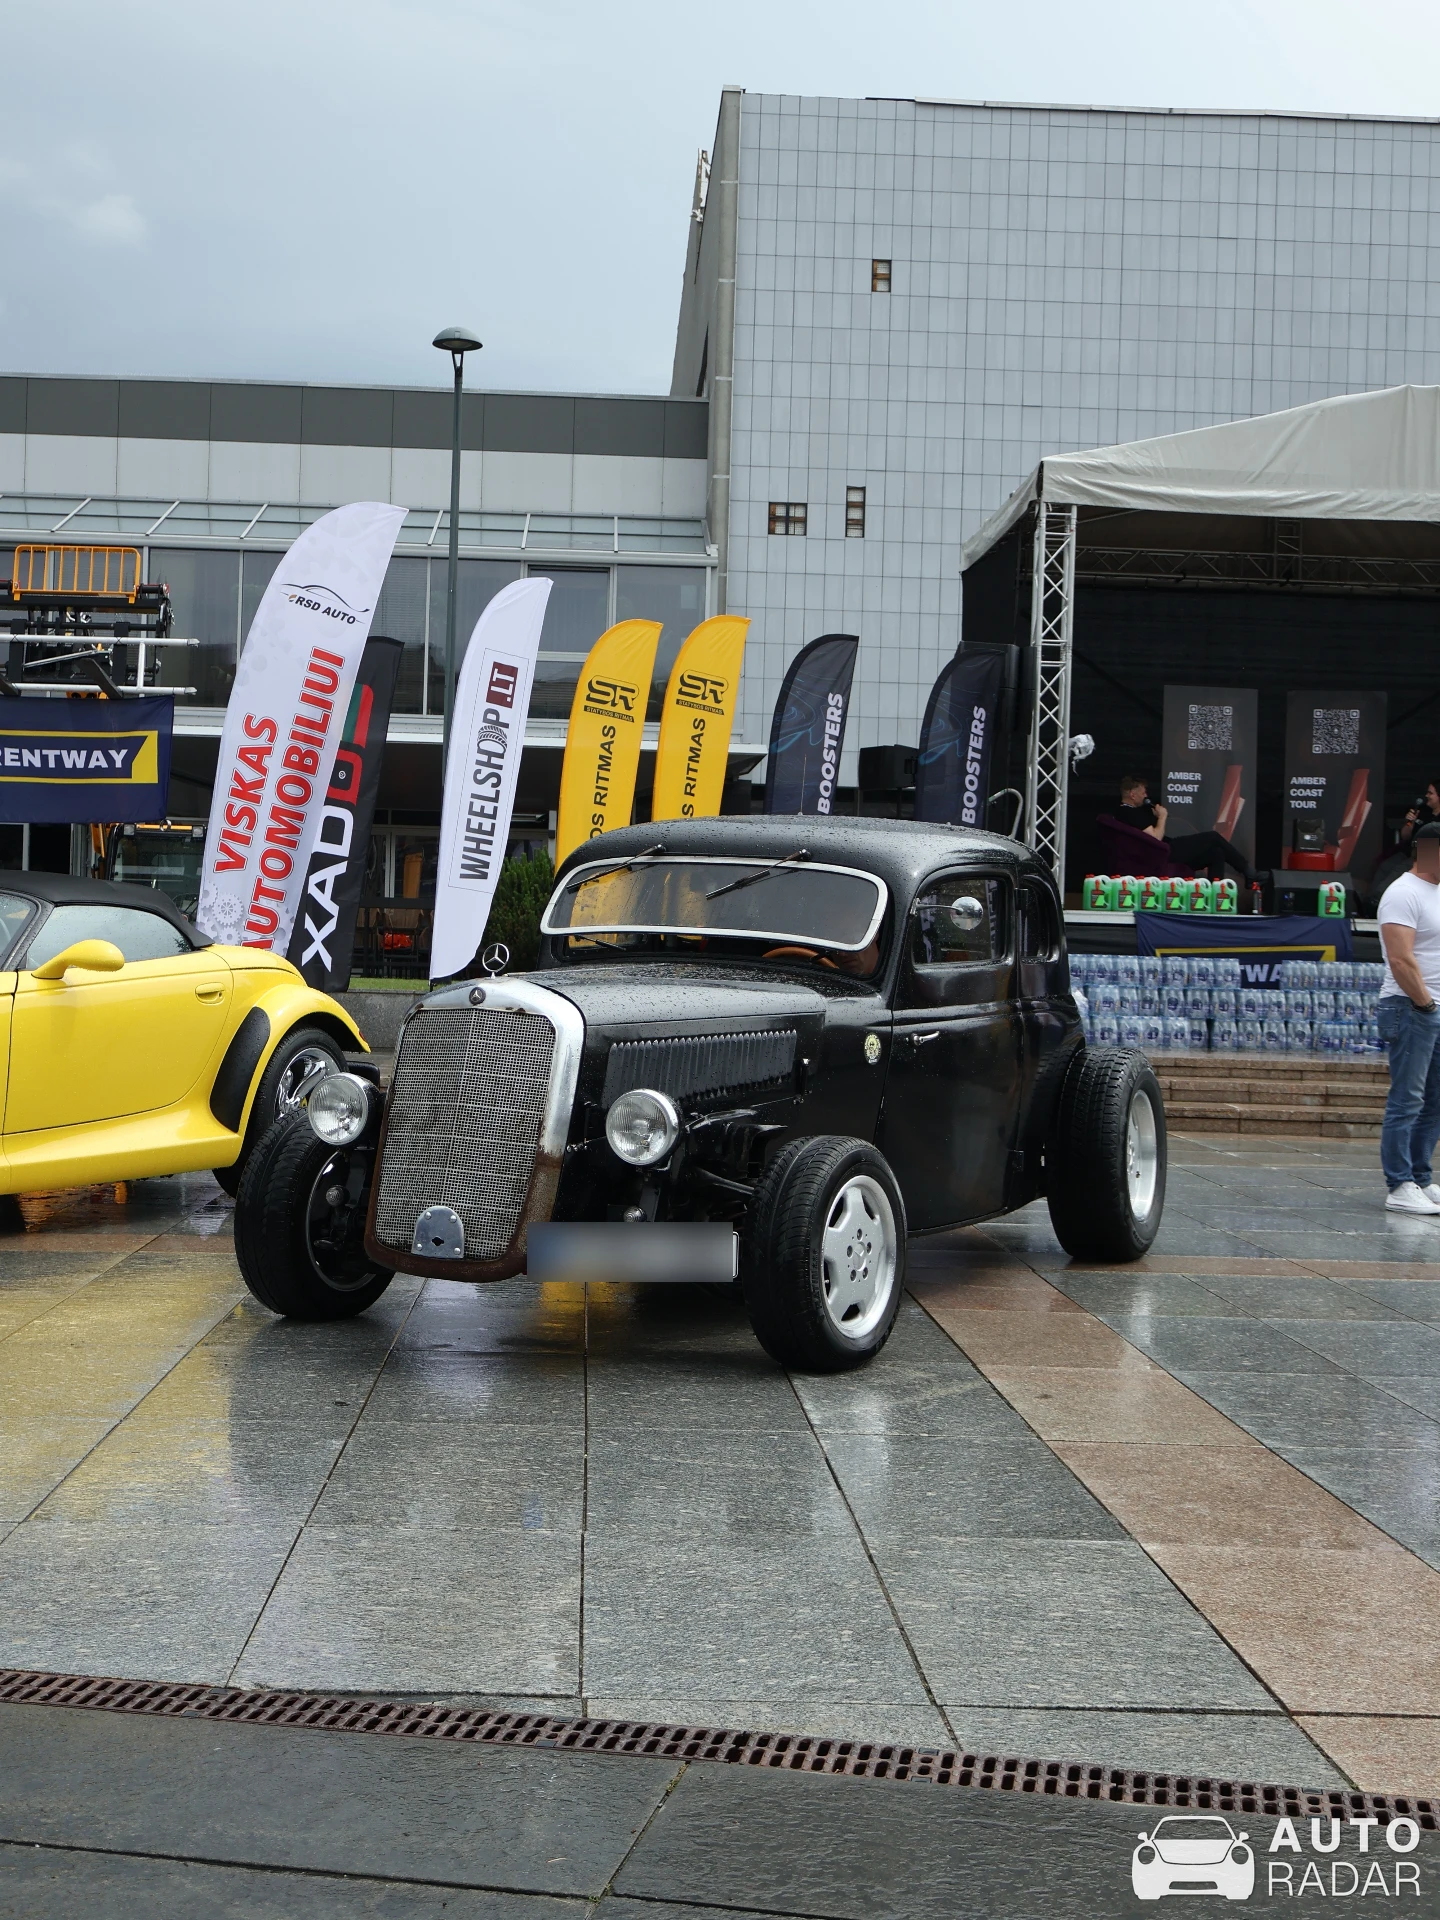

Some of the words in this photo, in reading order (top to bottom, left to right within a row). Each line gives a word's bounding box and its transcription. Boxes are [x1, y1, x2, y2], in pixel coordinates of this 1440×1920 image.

[322, 606, 356, 625] AUTO
[586, 675, 640, 711] SR
[678, 669, 729, 704] SR
[0, 747, 128, 769] ENTWAY
[683, 717, 706, 797] RITMAS
[817, 692, 843, 815] BOOSTERS
[962, 705, 986, 824] BOOSTERS
[593, 725, 616, 807] RITMAS
[1167, 771, 1202, 781] AMBER
[214, 712, 279, 873] VISKAS
[1167, 783, 1200, 793] COAST
[1290, 777, 1327, 786] AMBER
[1290, 788, 1324, 797] COAST
[1167, 795, 1193, 804] TOUR
[1290, 800, 1317, 809] TOUR
